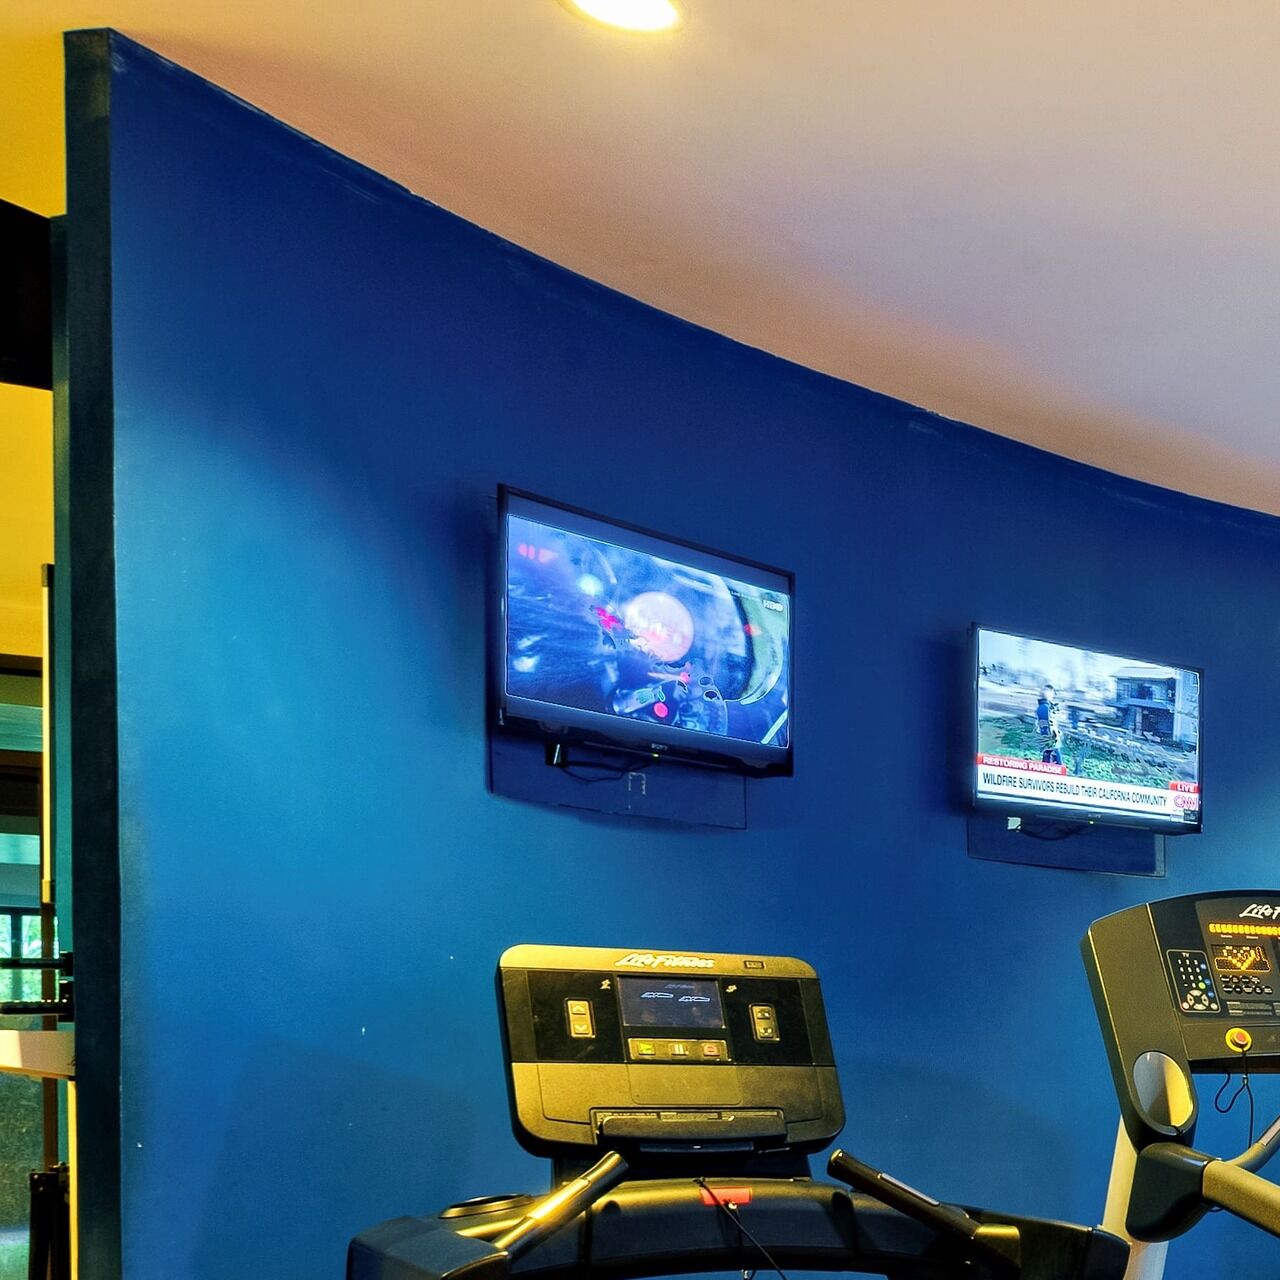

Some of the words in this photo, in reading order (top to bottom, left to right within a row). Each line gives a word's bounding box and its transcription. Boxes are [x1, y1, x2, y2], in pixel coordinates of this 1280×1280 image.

[983, 756, 1027, 770] RESTORING
[983, 772, 1017, 788] WILDFIRE
[1019, 777, 1054, 793] SURVIVORS
[1056, 782, 1079, 796] REBUILD
[1081, 785, 1097, 798] THEIR
[1099, 788, 1130, 802] CALIFORNIA
[1132, 792, 1167, 806] COMMUNITY
[1177, 783, 1195, 793] LIVE
[1238, 903, 1274, 919] Life
